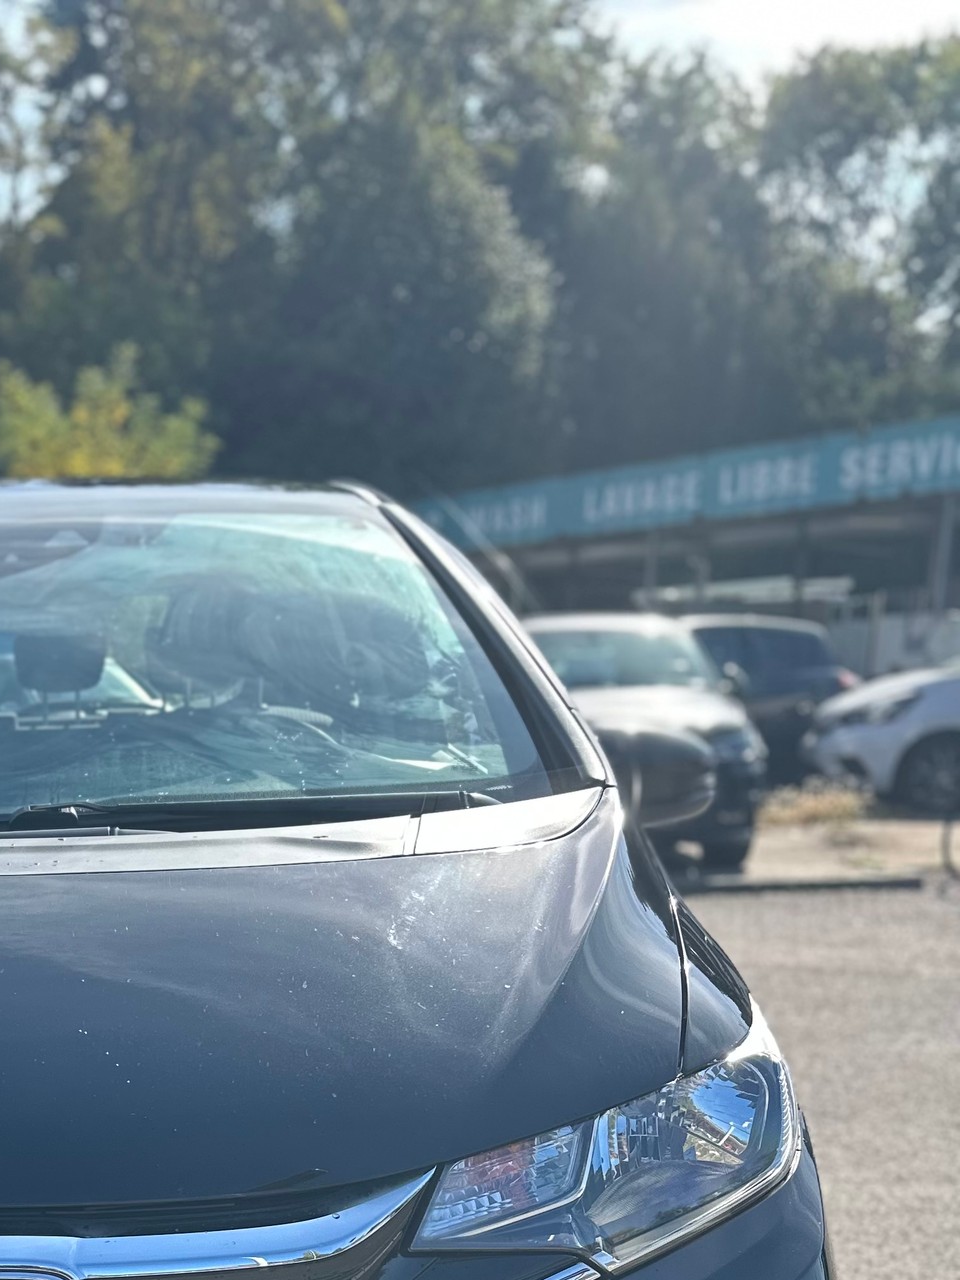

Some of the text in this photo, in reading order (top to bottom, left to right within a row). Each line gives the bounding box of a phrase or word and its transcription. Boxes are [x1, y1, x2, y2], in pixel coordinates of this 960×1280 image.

[584, 471, 699, 521] LAVAGE
[719, 453, 817, 503] LIBRE
[840, 433, 960, 488] SERVI
